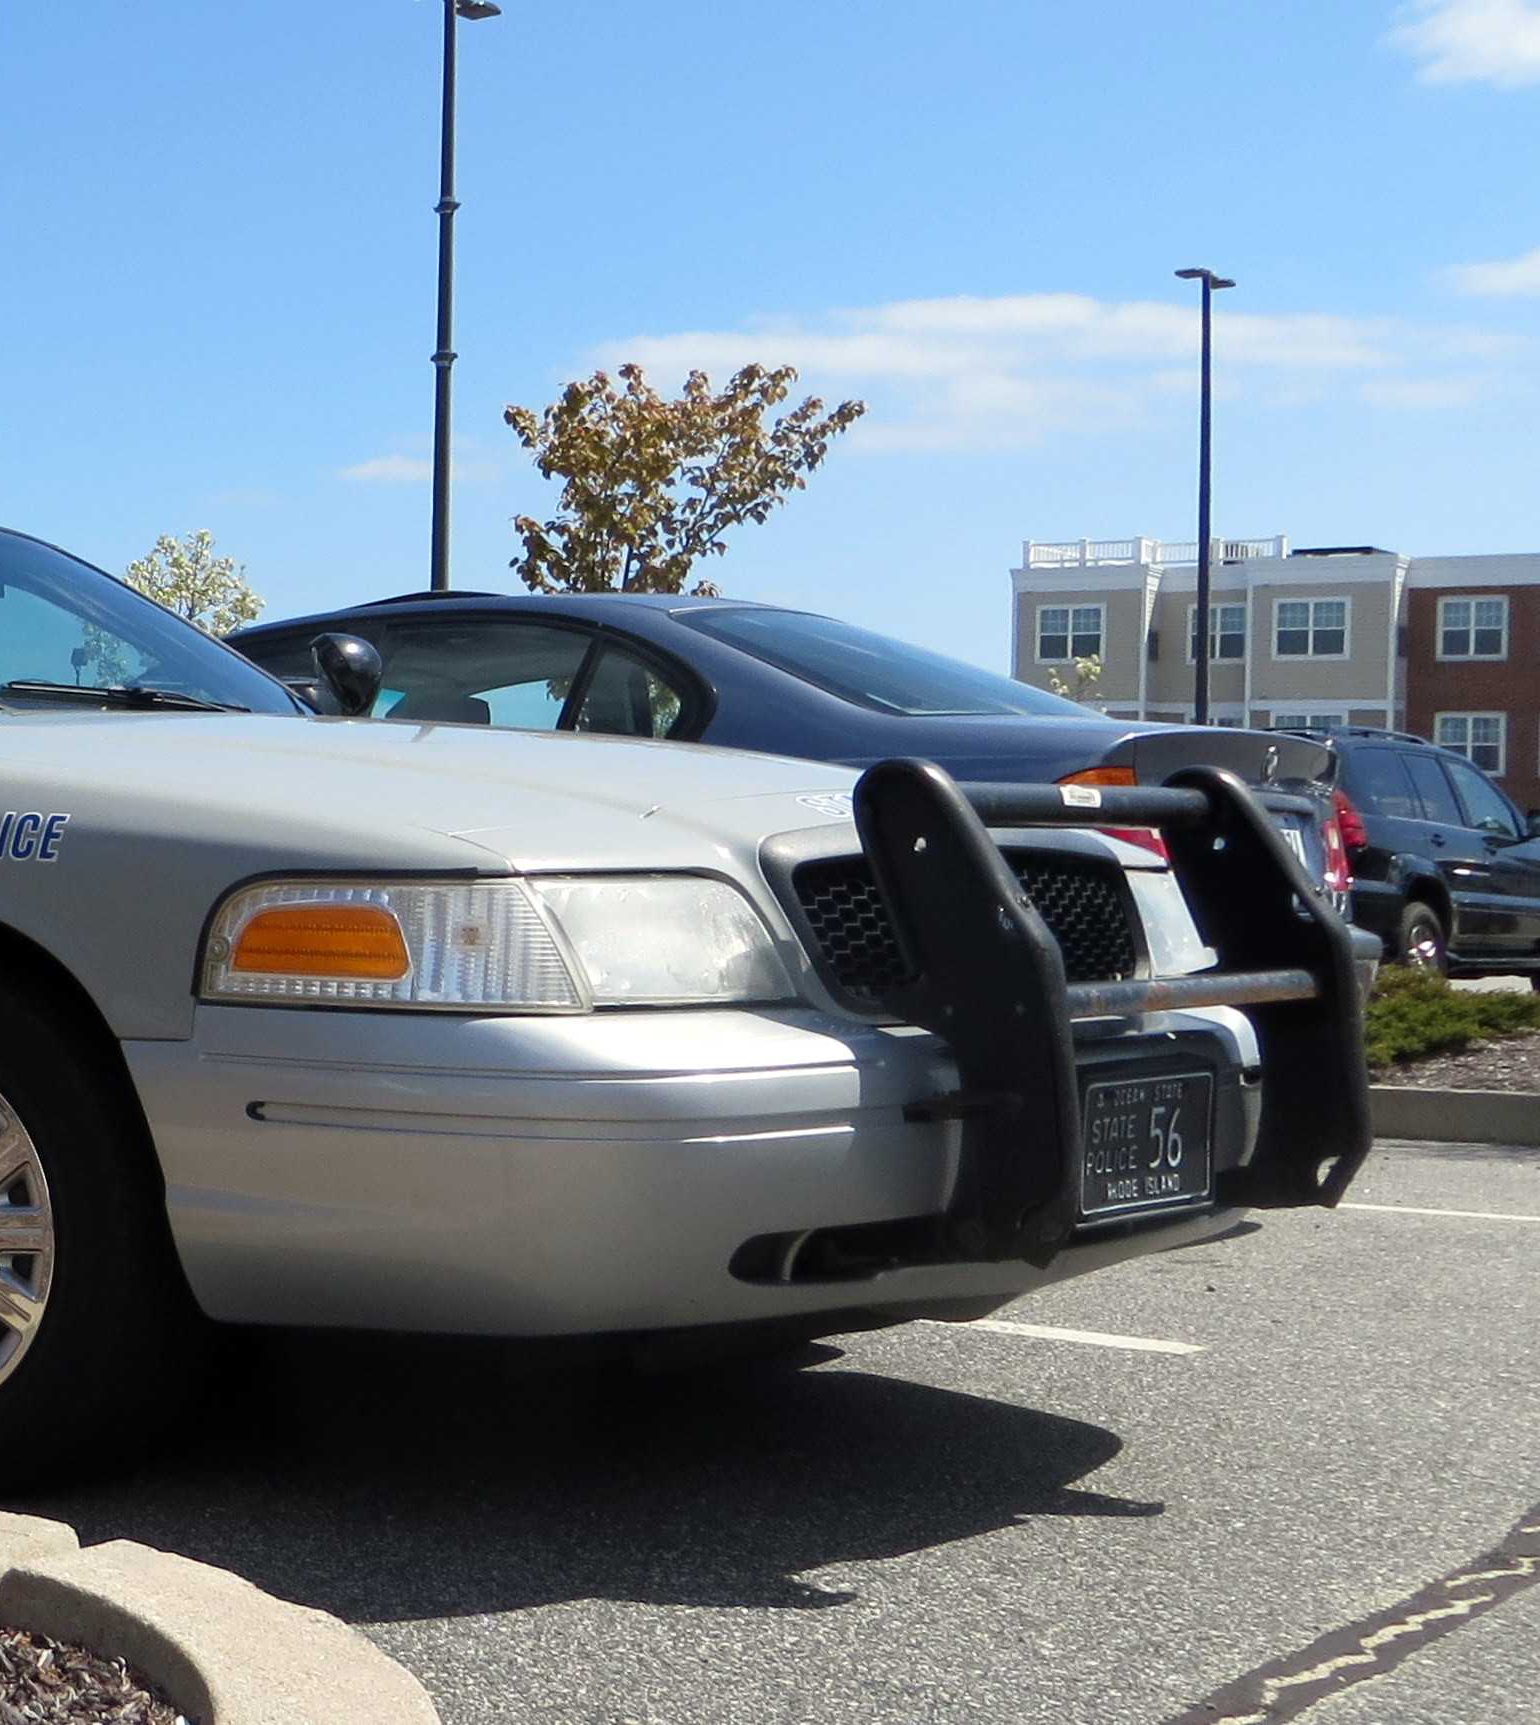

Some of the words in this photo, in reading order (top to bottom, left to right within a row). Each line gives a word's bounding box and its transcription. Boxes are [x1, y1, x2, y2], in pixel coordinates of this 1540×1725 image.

[1154, 1083, 1183, 1101] STATE
[1092, 1114, 1137, 1144] STATE
[1149, 1106, 1182, 1168] 56
[1086, 1145, 1138, 1176] POLICE
[1107, 1178, 1139, 1200] RHODE
[1145, 1174, 1181, 1196] ISLAND
